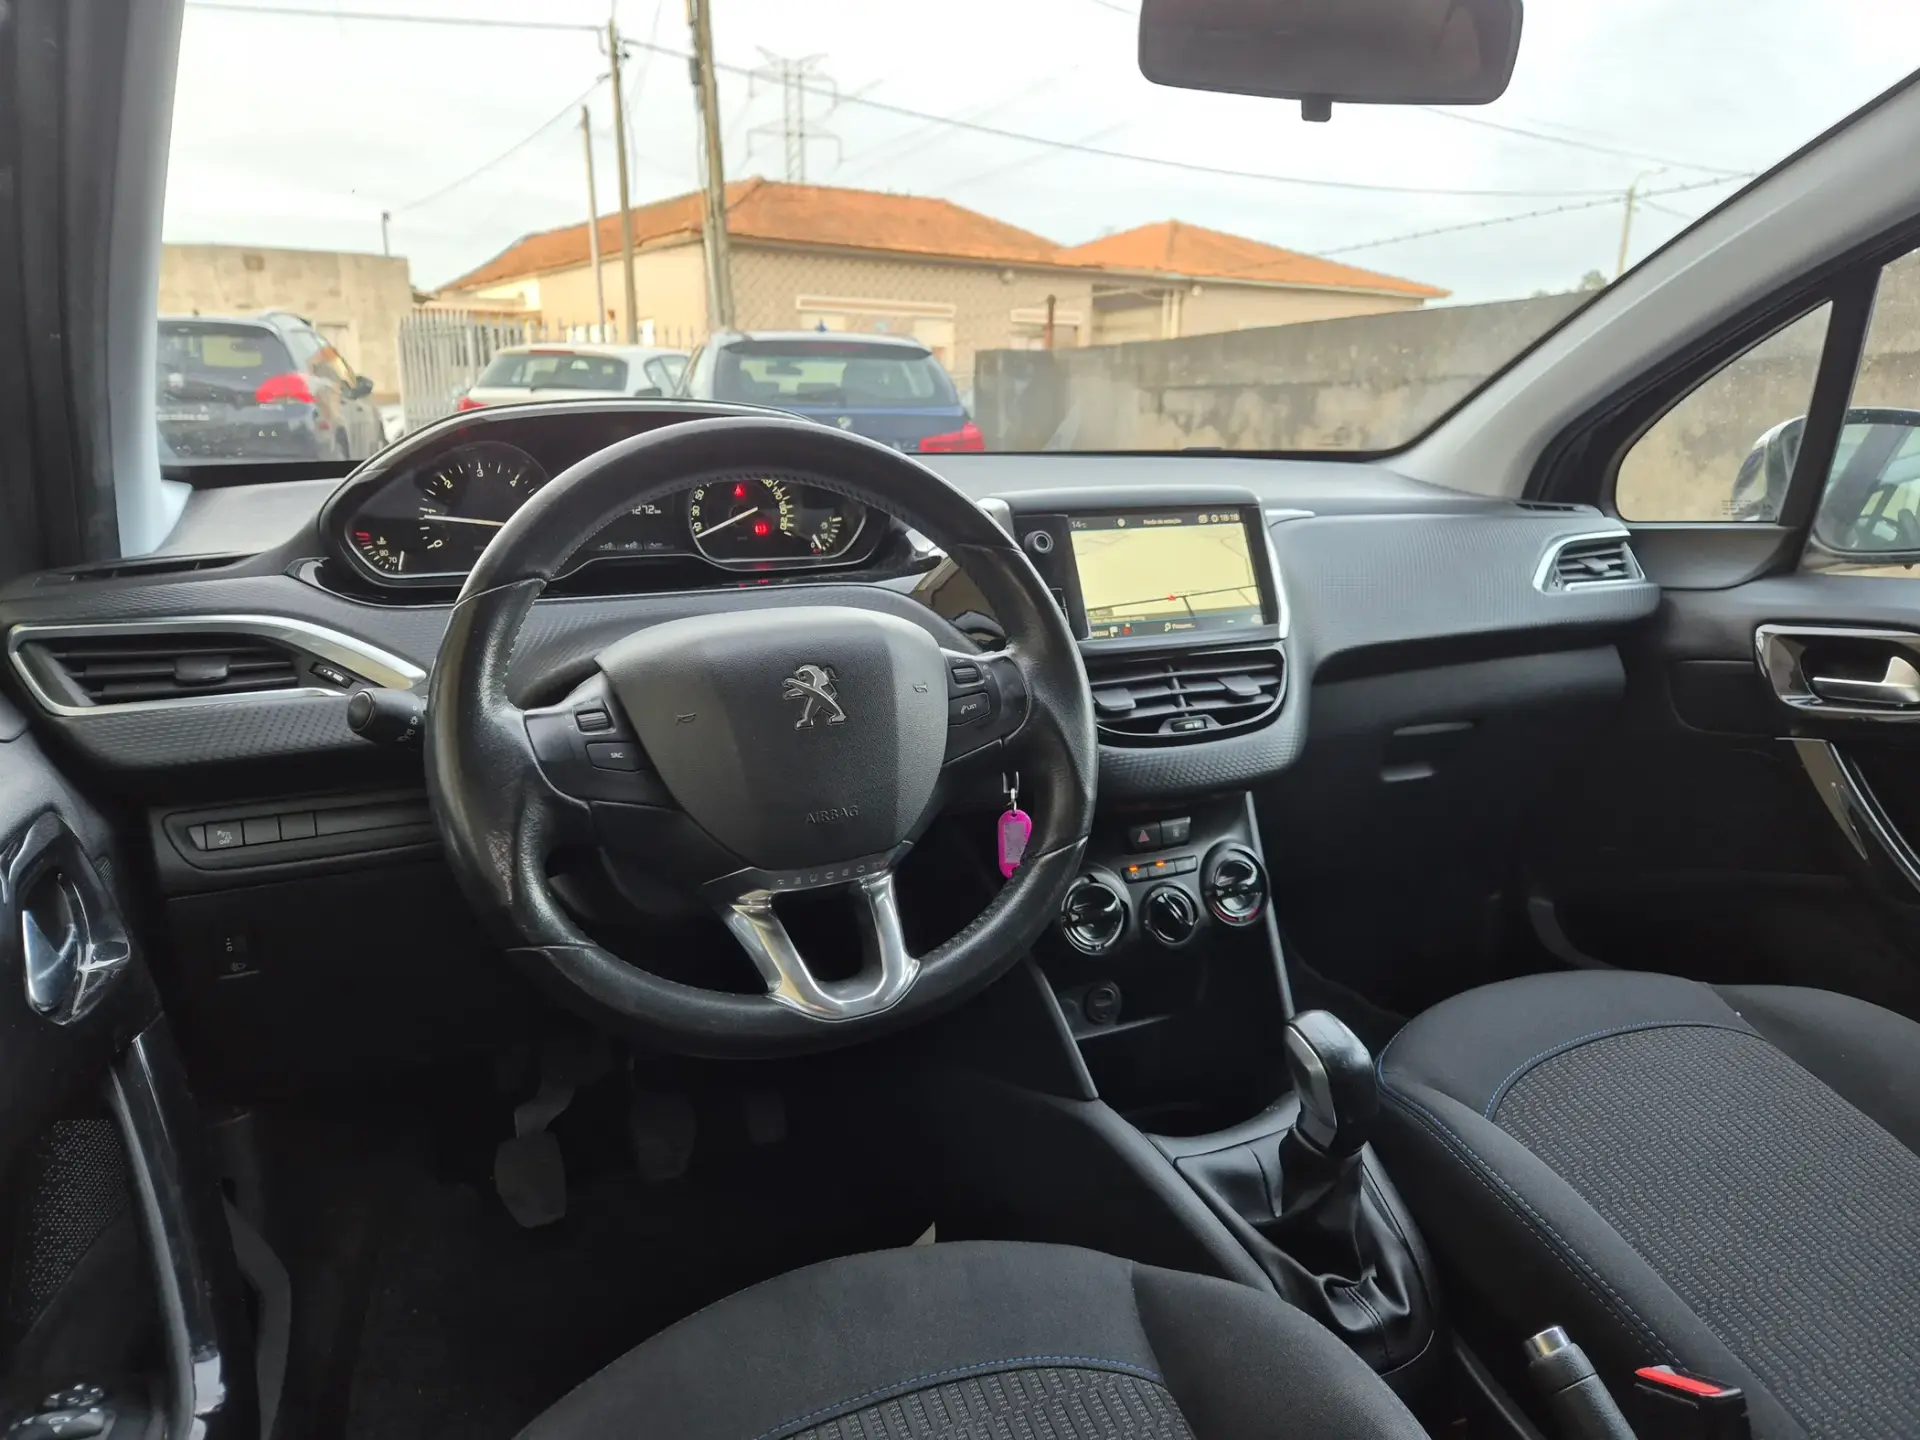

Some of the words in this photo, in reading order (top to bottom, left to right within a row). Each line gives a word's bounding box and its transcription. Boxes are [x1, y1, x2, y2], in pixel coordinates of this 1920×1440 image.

[476, 469, 484, 478] 3
[444, 479, 454, 489] 2
[509, 479, 518, 488] 4
[695, 489, 704, 500] 50
[692, 505, 700, 516] 30
[693, 522, 702, 532] 10
[433, 539, 443, 548] 0
[388, 556, 398, 564] 70
[805, 804, 860, 825] AIRBAG
